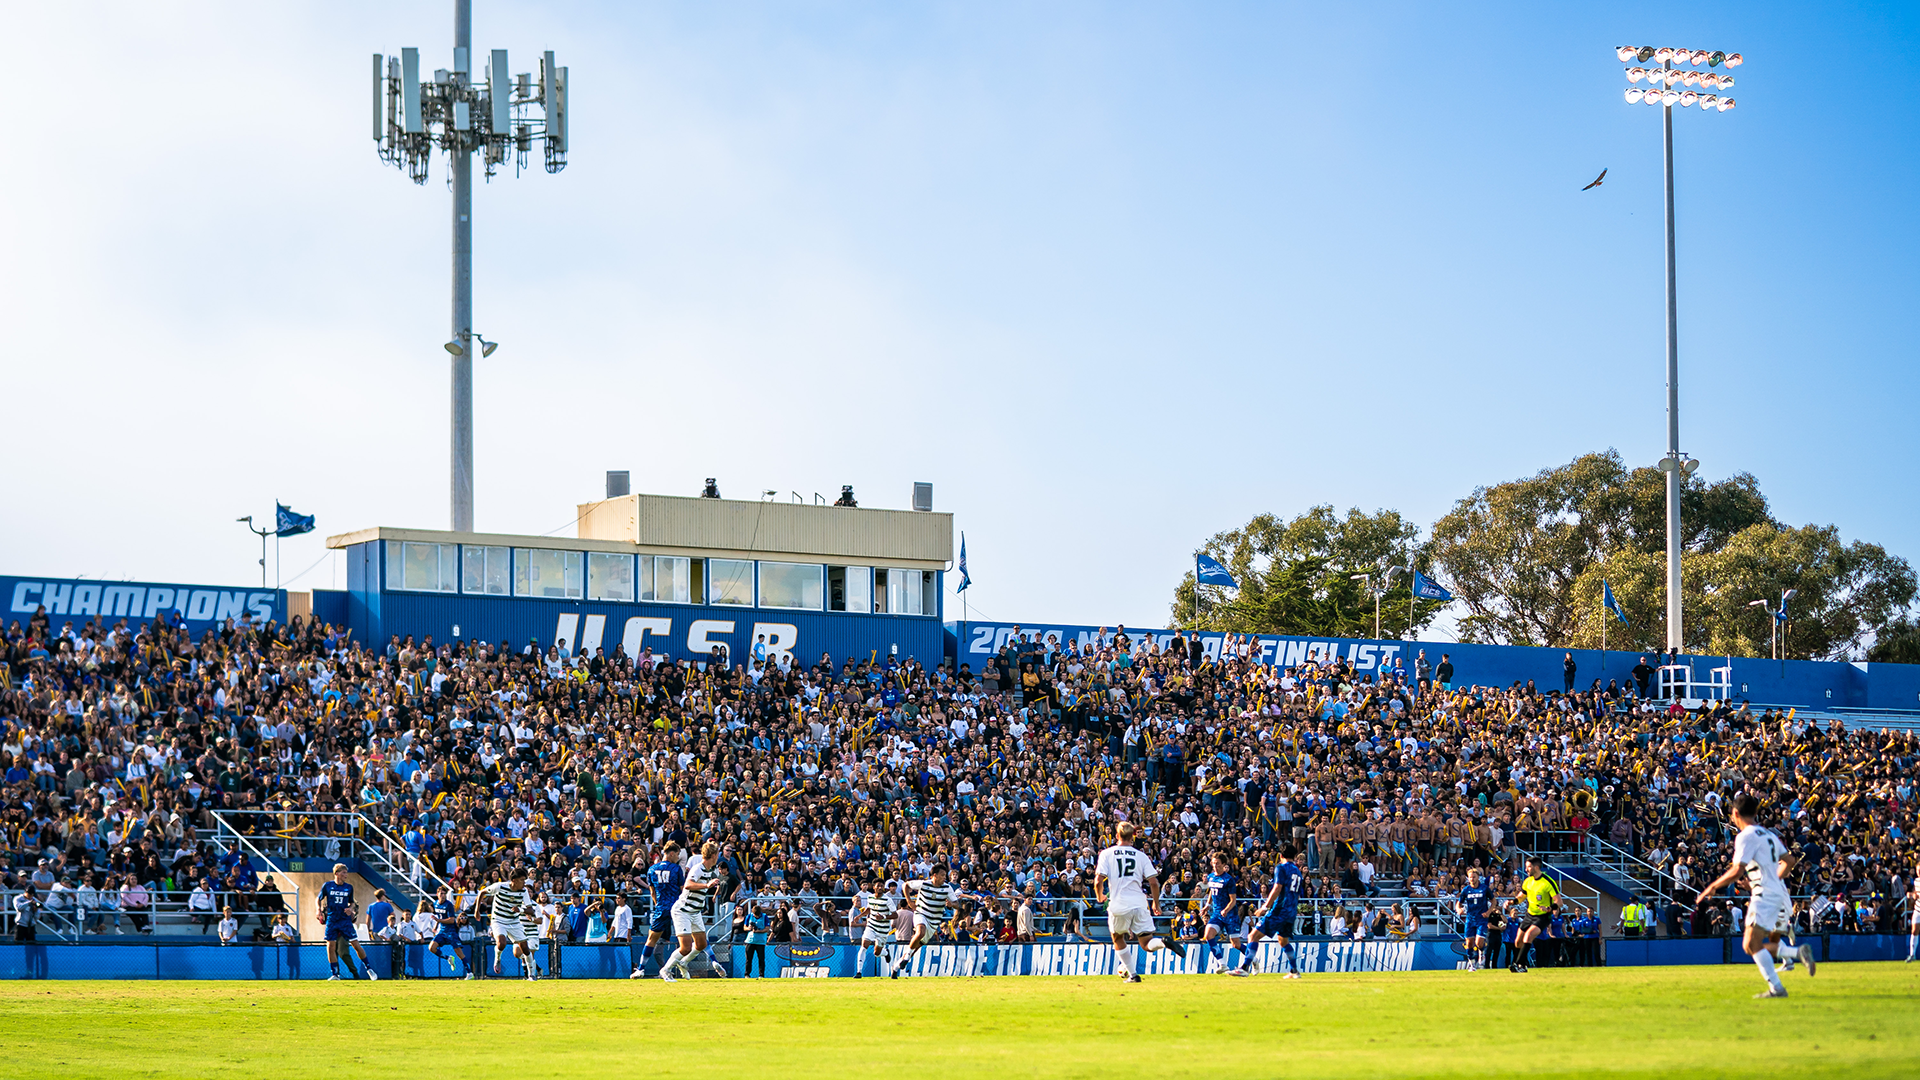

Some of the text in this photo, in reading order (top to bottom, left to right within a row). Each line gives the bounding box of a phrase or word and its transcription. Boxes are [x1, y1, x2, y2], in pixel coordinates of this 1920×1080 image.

[11, 581, 275, 622] CHAMPIONS
[552, 612, 798, 675] UCSB
[1257, 639, 1401, 669] FINALIST
[1767, 838, 1777, 863] 2
[291, 862, 303, 871] EXIT
[1116, 858, 1136, 878] 12
[654, 870, 670, 884] 10
[1290, 873, 1301, 893] 21
[334, 896, 344, 904] 33
[77, 908, 85, 920] 8
[1314, 913, 1320, 924] 9
[996, 944, 1023, 976] TO
[1145, 943, 1201, 975] FIELD
[1238, 942, 1321, 974] ARDER
[1324, 941, 1416, 972] STADIUM
[779, 966, 830, 979] UCSB
